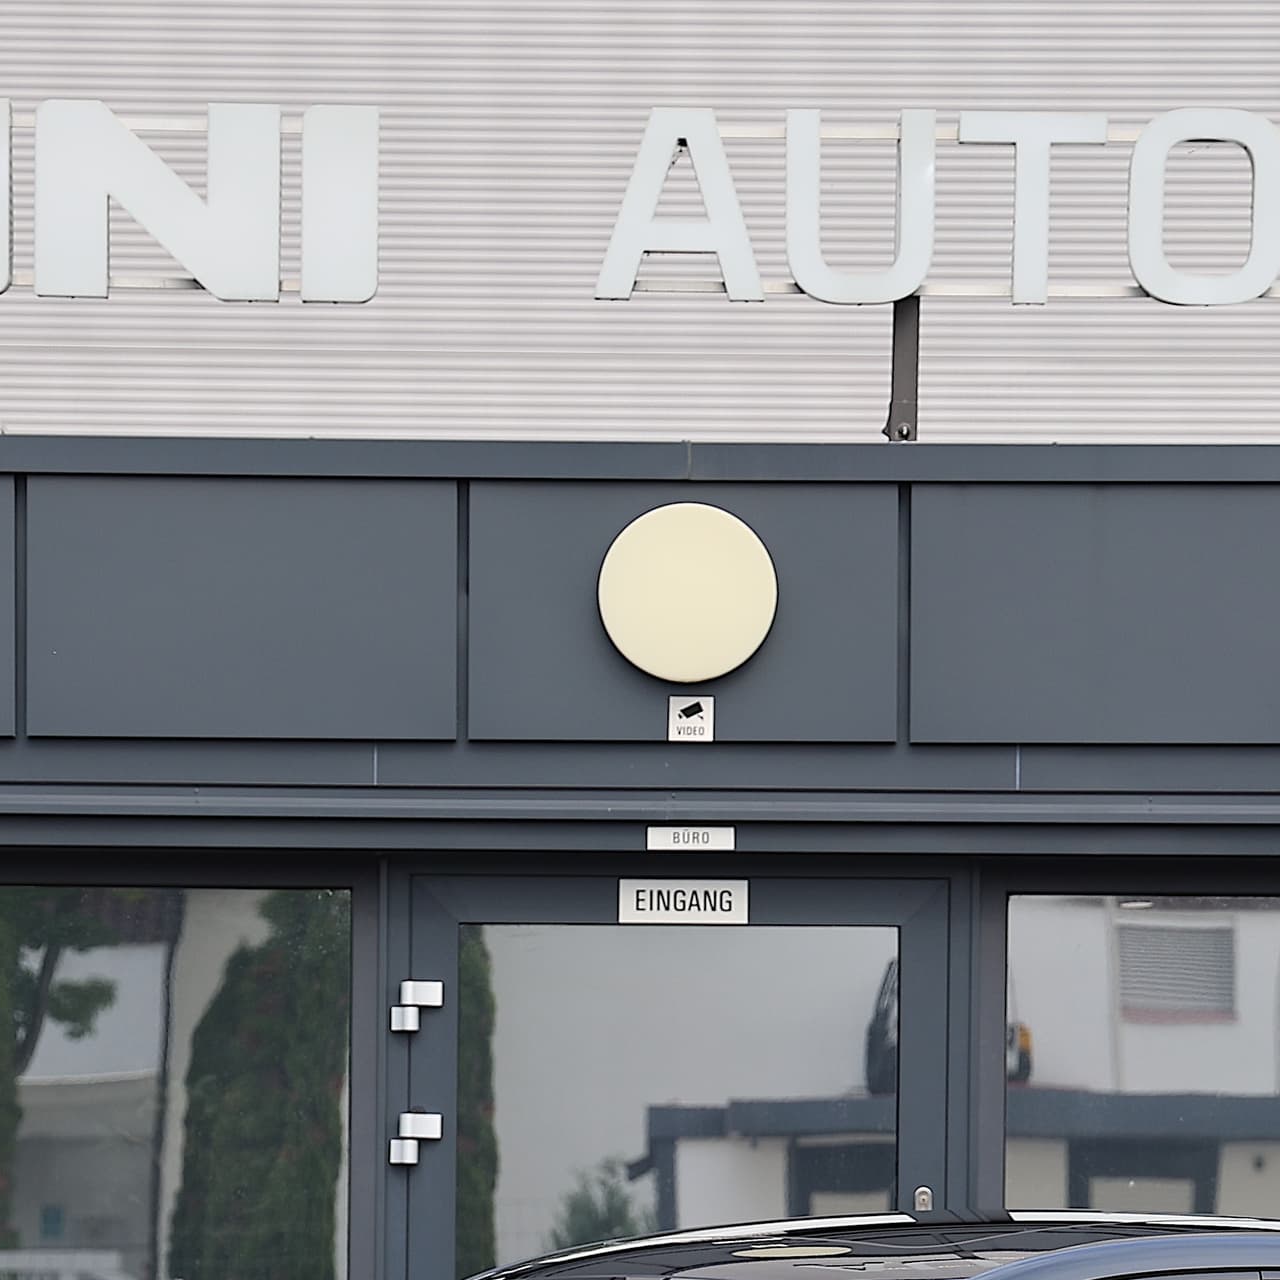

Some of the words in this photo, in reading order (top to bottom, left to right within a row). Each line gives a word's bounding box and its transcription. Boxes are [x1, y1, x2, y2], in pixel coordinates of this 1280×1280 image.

[676, 726, 705, 736] VIDEO
[672, 829, 710, 844] BÜRO
[635, 889, 733, 912] EINGANG
